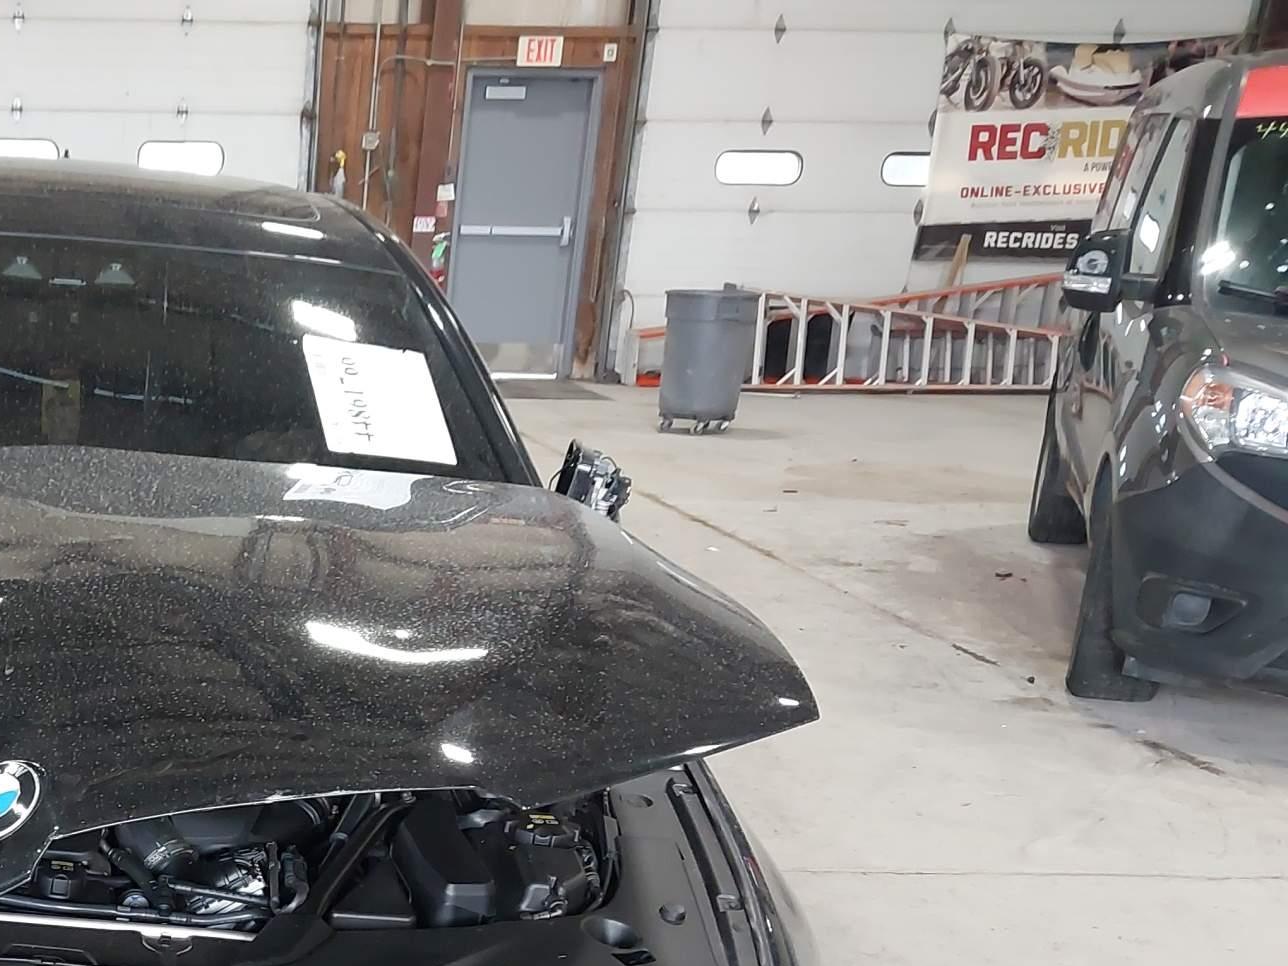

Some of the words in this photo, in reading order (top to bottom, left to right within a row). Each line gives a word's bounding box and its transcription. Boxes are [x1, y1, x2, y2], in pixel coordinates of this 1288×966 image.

[526, 38, 557, 63] EXIT
[968, 123, 1049, 161] REC
[983, 231, 1080, 249] RECRIDES
